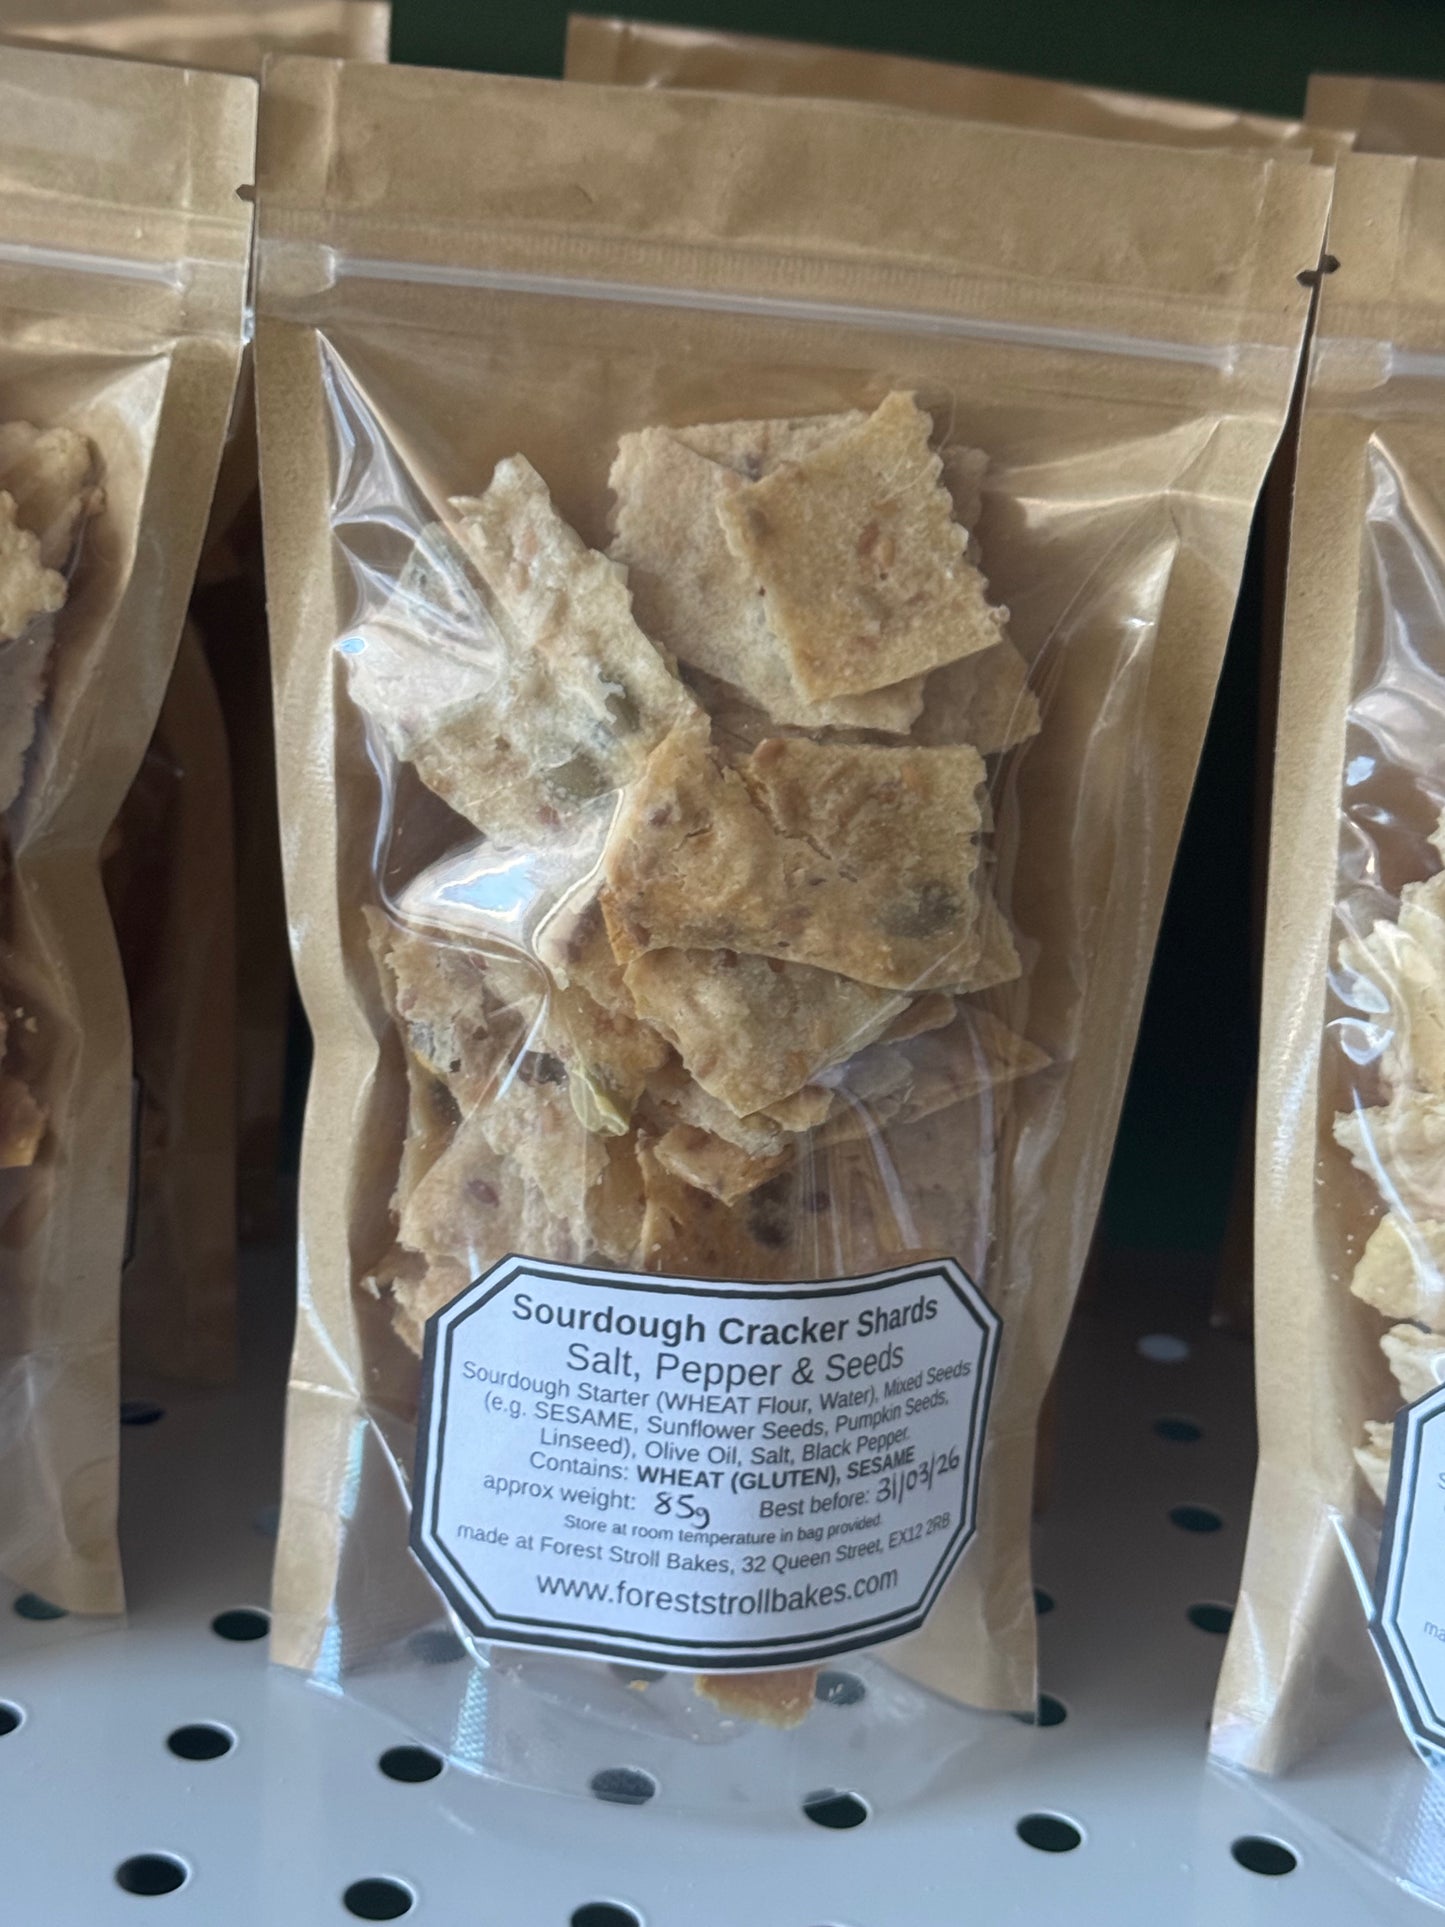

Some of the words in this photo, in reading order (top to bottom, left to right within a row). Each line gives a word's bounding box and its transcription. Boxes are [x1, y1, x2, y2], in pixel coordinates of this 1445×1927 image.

[512, 1293, 705, 1347] Sourdough
[719, 1316, 849, 1345] Cracker
[856, 1295, 938, 1337] Shards
[463, 1361, 570, 1399] Sourdough
[577, 1382, 650, 1407] Starter
[656, 1390, 750, 1414] (WHEAT
[758, 1396, 812, 1415] Flour,
[884, 1370, 922, 1398] Mixed
[926, 1360, 971, 1383] Seeds
[566, 1342, 640, 1382] Salt,
[656, 1352, 782, 1392] Pepper
[792, 1357, 814, 1385] &
[825, 1342, 904, 1382] Seeds
[485, 1390, 526, 1419] (e.g.
[535, 1401, 639, 1434] SESAME,
[647, 1416, 754, 1439] Sunflower
[762, 1419, 829, 1440] Seeds,
[835, 1406, 902, 1435] Pumpkin
[905, 1389, 949, 1416] Seeds,
[530, 1451, 629, 1480] Contains:
[637, 1464, 724, 1489] WHEAT
[731, 1465, 841, 1494] (GLUTEN),
[847, 1445, 915, 1480] SESAME
[540, 1427, 636, 1459] Linseed),
[645, 1440, 699, 1462] Olive
[708, 1446, 742, 1468] Oil,
[751, 1446, 795, 1466] Salt,
[802, 1439, 851, 1462] Black
[484, 1474, 553, 1499] approx
[560, 1487, 635, 1511] weight:
[654, 1491, 710, 1530] 85g
[759, 1499, 804, 1519] Best
[810, 1490, 870, 1515] before:
[876, 1446, 960, 1504] 31/03/26
[457, 1523, 509, 1546] made
[516, 1535, 533, 1550] at
[540, 1536, 603, 1560] Forest
[609, 1545, 660, 1567] Stroll
[667, 1552, 735, 1576] Bakes,
[742, 1555, 765, 1573] 32
[772, 1549, 830, 1574] Queen
[836, 1539, 883, 1562] Street,
[888, 1525, 922, 1549] EX12
[564, 1514, 607, 1533] Store
[613, 1522, 627, 1535] at
[631, 1526, 673, 1542] room
[678, 1529, 775, 1547] temperature
[780, 1525, 793, 1542] in
[797, 1522, 823, 1543] bag
[537, 1568, 898, 1616] www.foreststrollbakes.com
